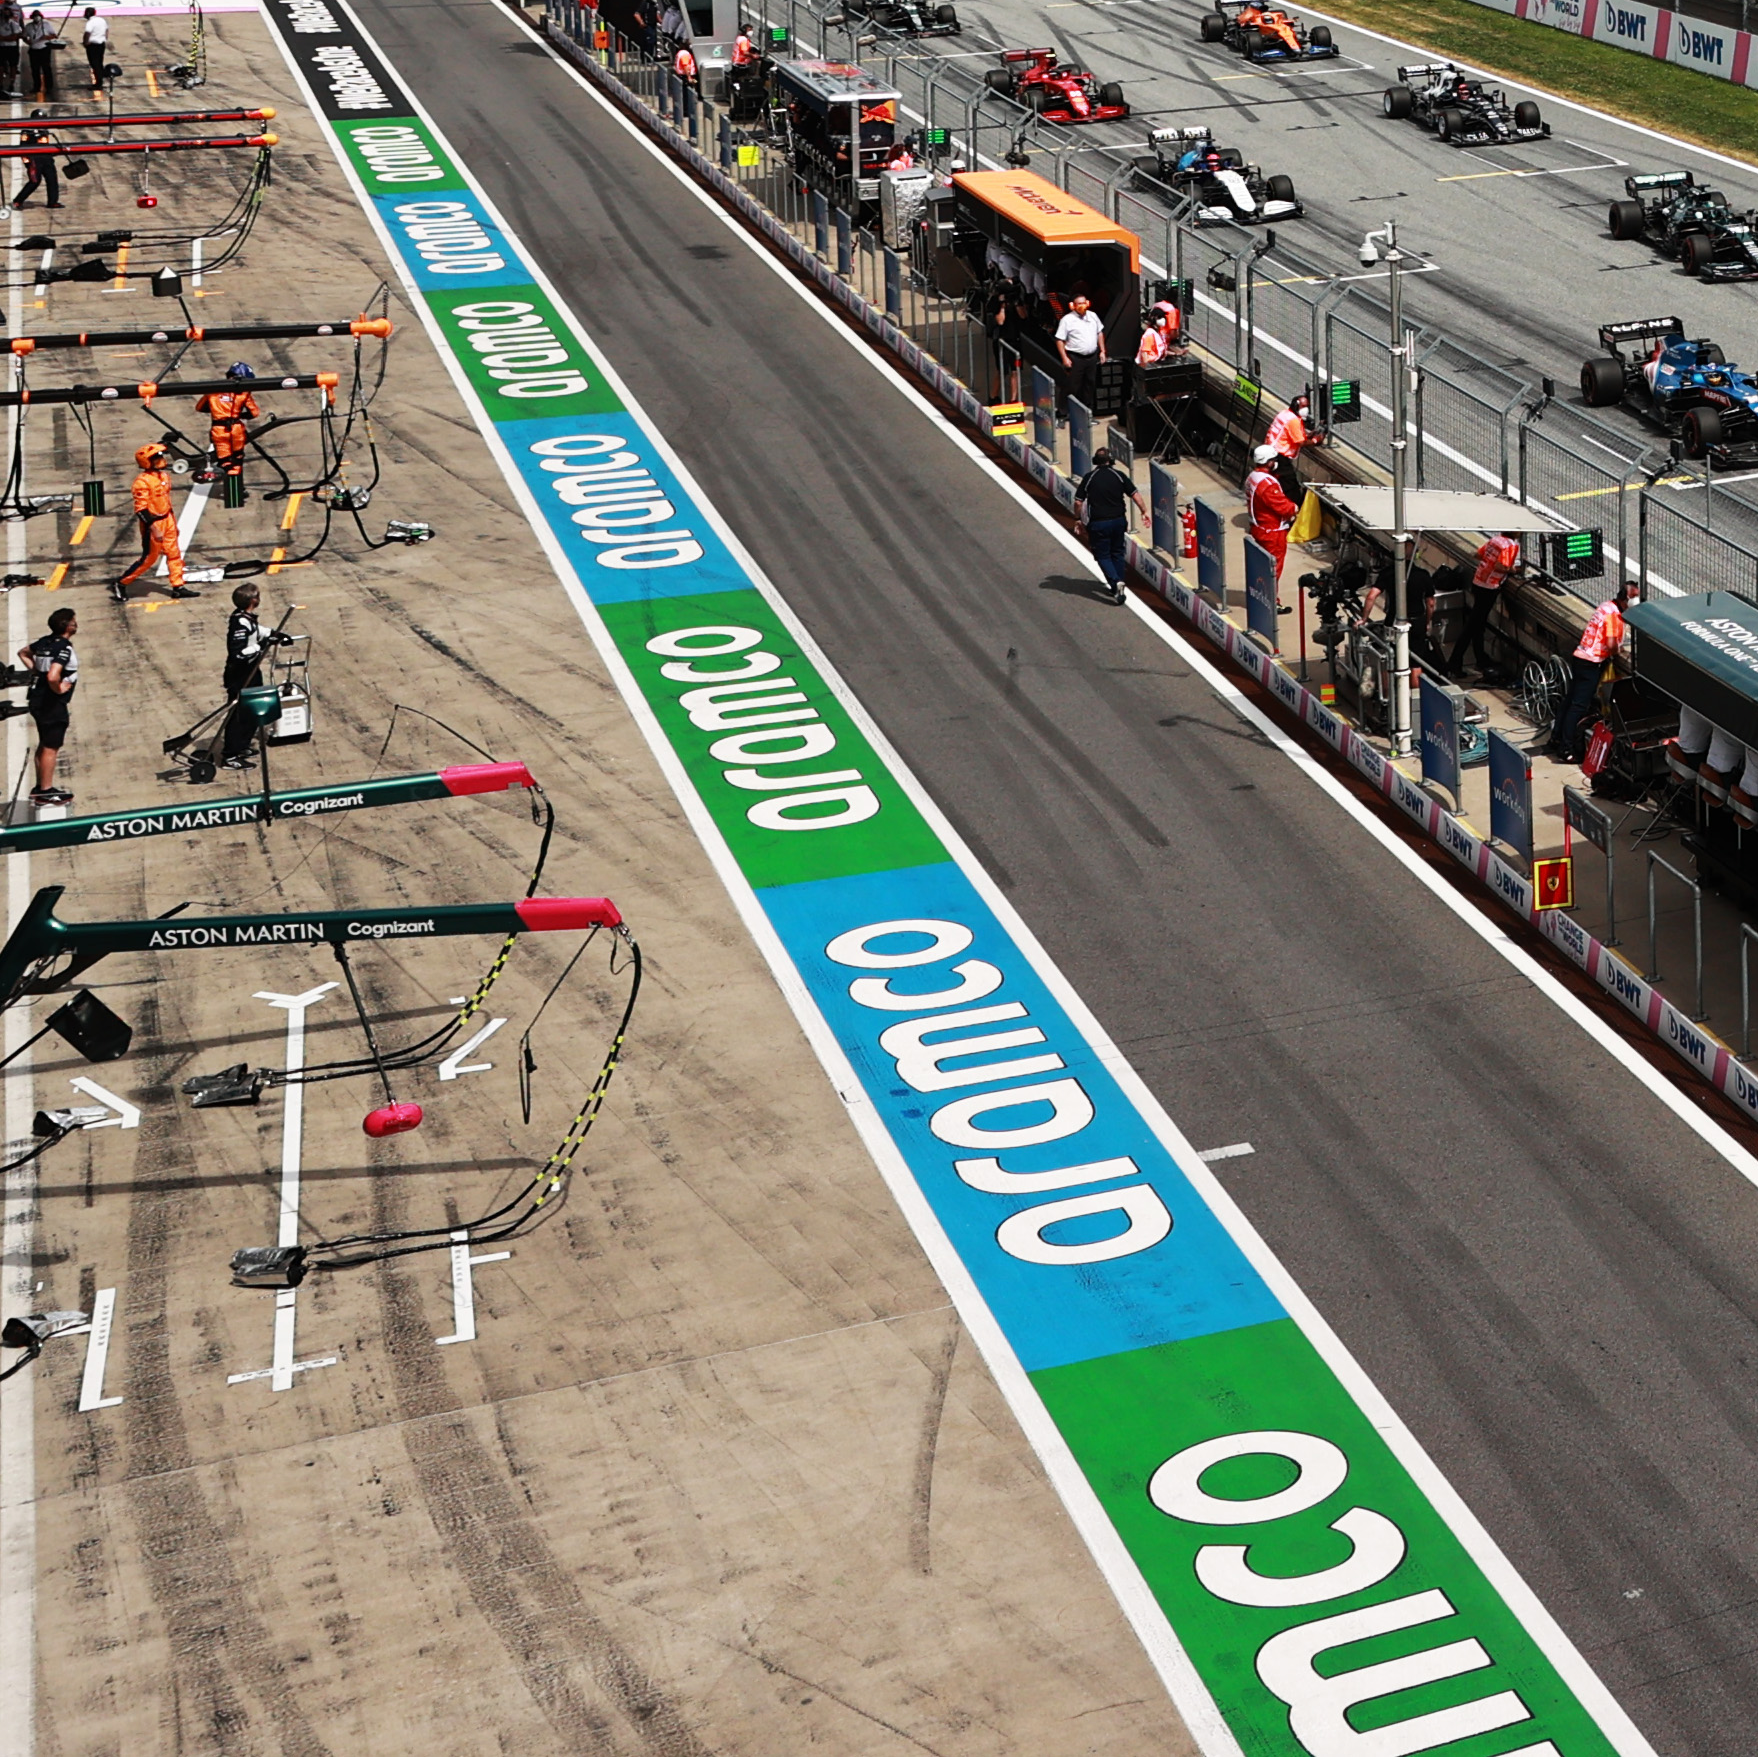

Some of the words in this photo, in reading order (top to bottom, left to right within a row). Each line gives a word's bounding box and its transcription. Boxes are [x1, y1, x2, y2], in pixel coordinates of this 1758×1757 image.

[1554, 0, 1579, 17] WORLD
[1617, 9, 1646, 41] BWT
[1692, 32, 1723, 65] BWT
[312, 46, 393, 109] #WeRaceAsOne
[348, 124, 446, 184] aramco
[393, 200, 505, 274] aramco
[449, 300, 590, 401] aramco
[528, 433, 706, 570] aramco
[1680, 620, 1728, 652] FORMULA
[1704, 618, 1758, 647] ASTON
[1244, 646, 1258, 672] BWT
[1280, 676, 1296, 705] BWT
[644, 624, 883, 836] aramco
[1319, 710, 1337, 741] BWT
[1426, 730, 1454, 765] workday
[86, 814, 167, 841] ASTON
[171, 803, 259, 832] MARTIN
[279, 791, 365, 816] Cognizant
[1406, 788, 1424, 819] BWT
[1493, 786, 1525, 825] workday
[1453, 830, 1473, 862] BWT
[1503, 873, 1525, 908] BWT
[148, 925, 228, 949] ASTON
[231, 921, 325, 943] MARTIN
[346, 917, 435, 940] Cognizant
[1557, 913, 1584, 944] CHANGE
[1562, 930, 1585, 955] WORLD
[1616, 970, 1642, 1009] BWT
[1679, 1024, 1706, 1066] BWT
[823, 917, 1176, 1269] aramco
[1147, 1429, 1562, 1757] mco
